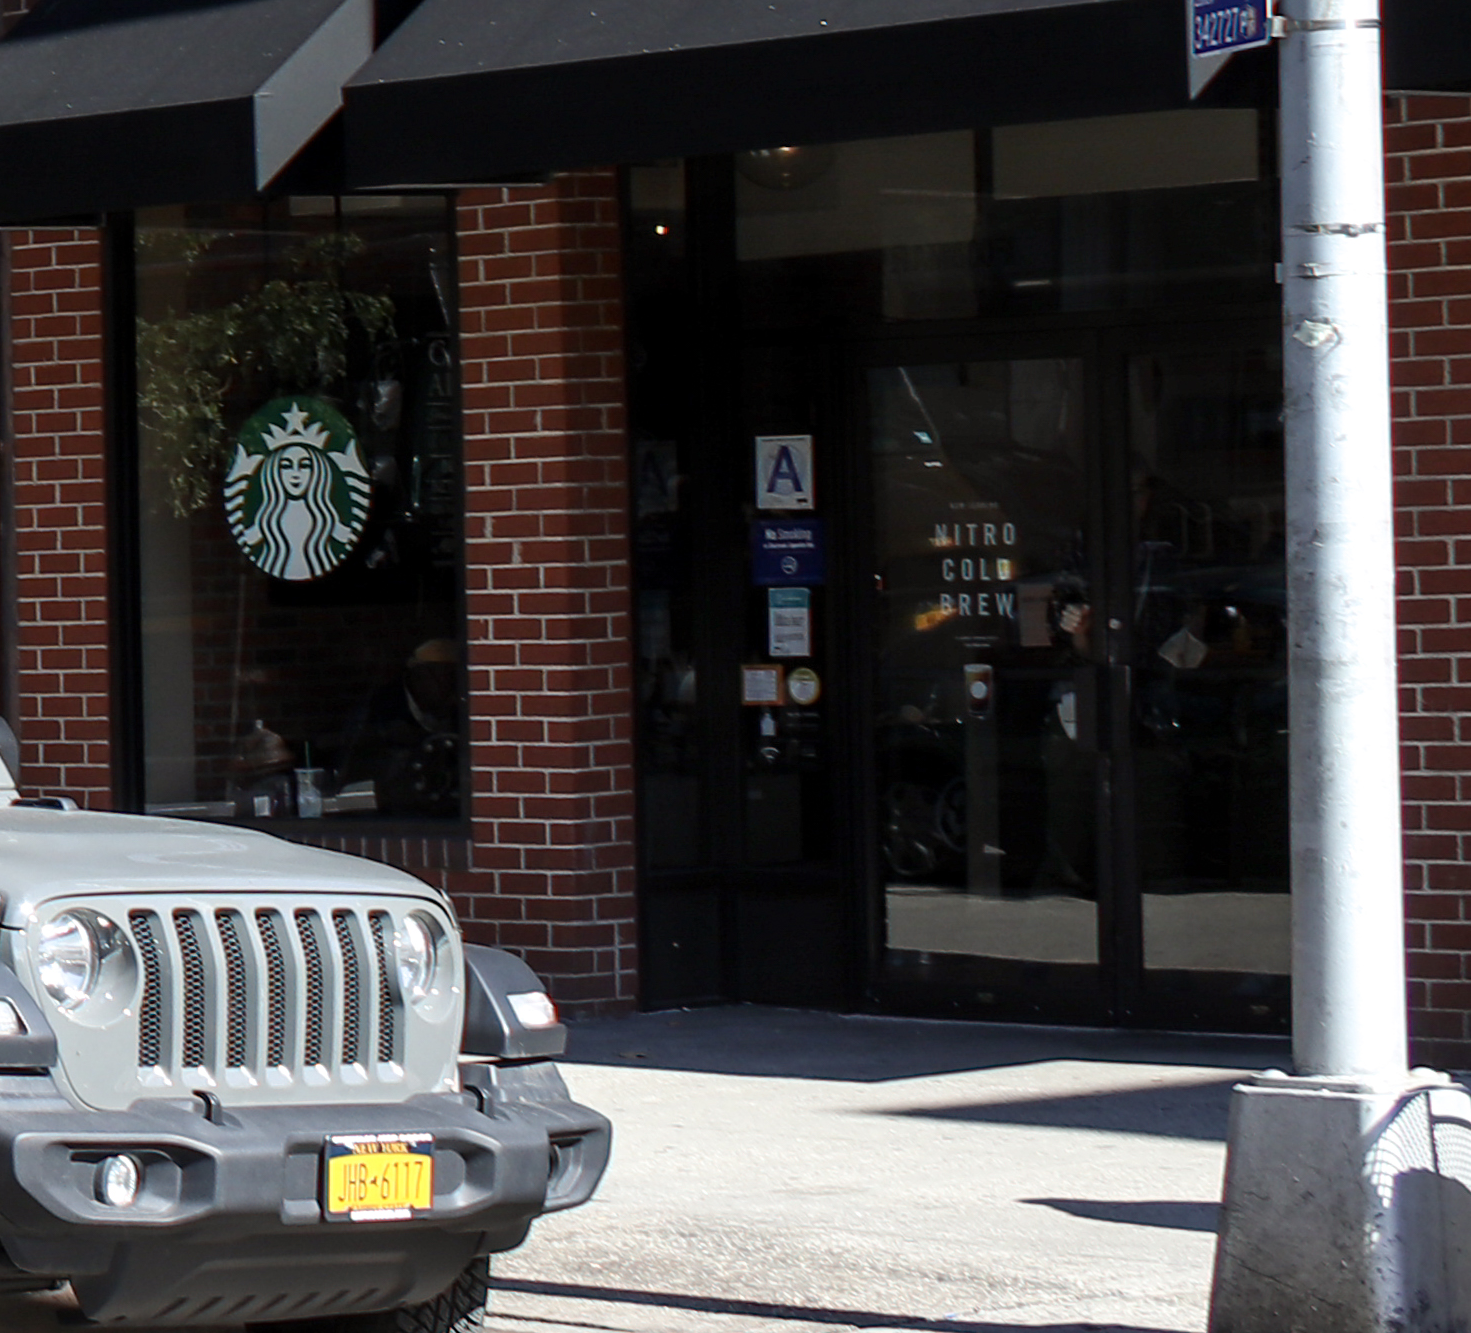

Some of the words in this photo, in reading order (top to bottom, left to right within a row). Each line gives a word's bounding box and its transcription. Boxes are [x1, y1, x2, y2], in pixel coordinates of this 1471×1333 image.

[1194, 6, 1240, 50] 342727
[767, 444, 804, 493] A
[934, 522, 1017, 546] NITRO
[941, 557, 1012, 582] COLD
[939, 593, 1015, 620] BREW
